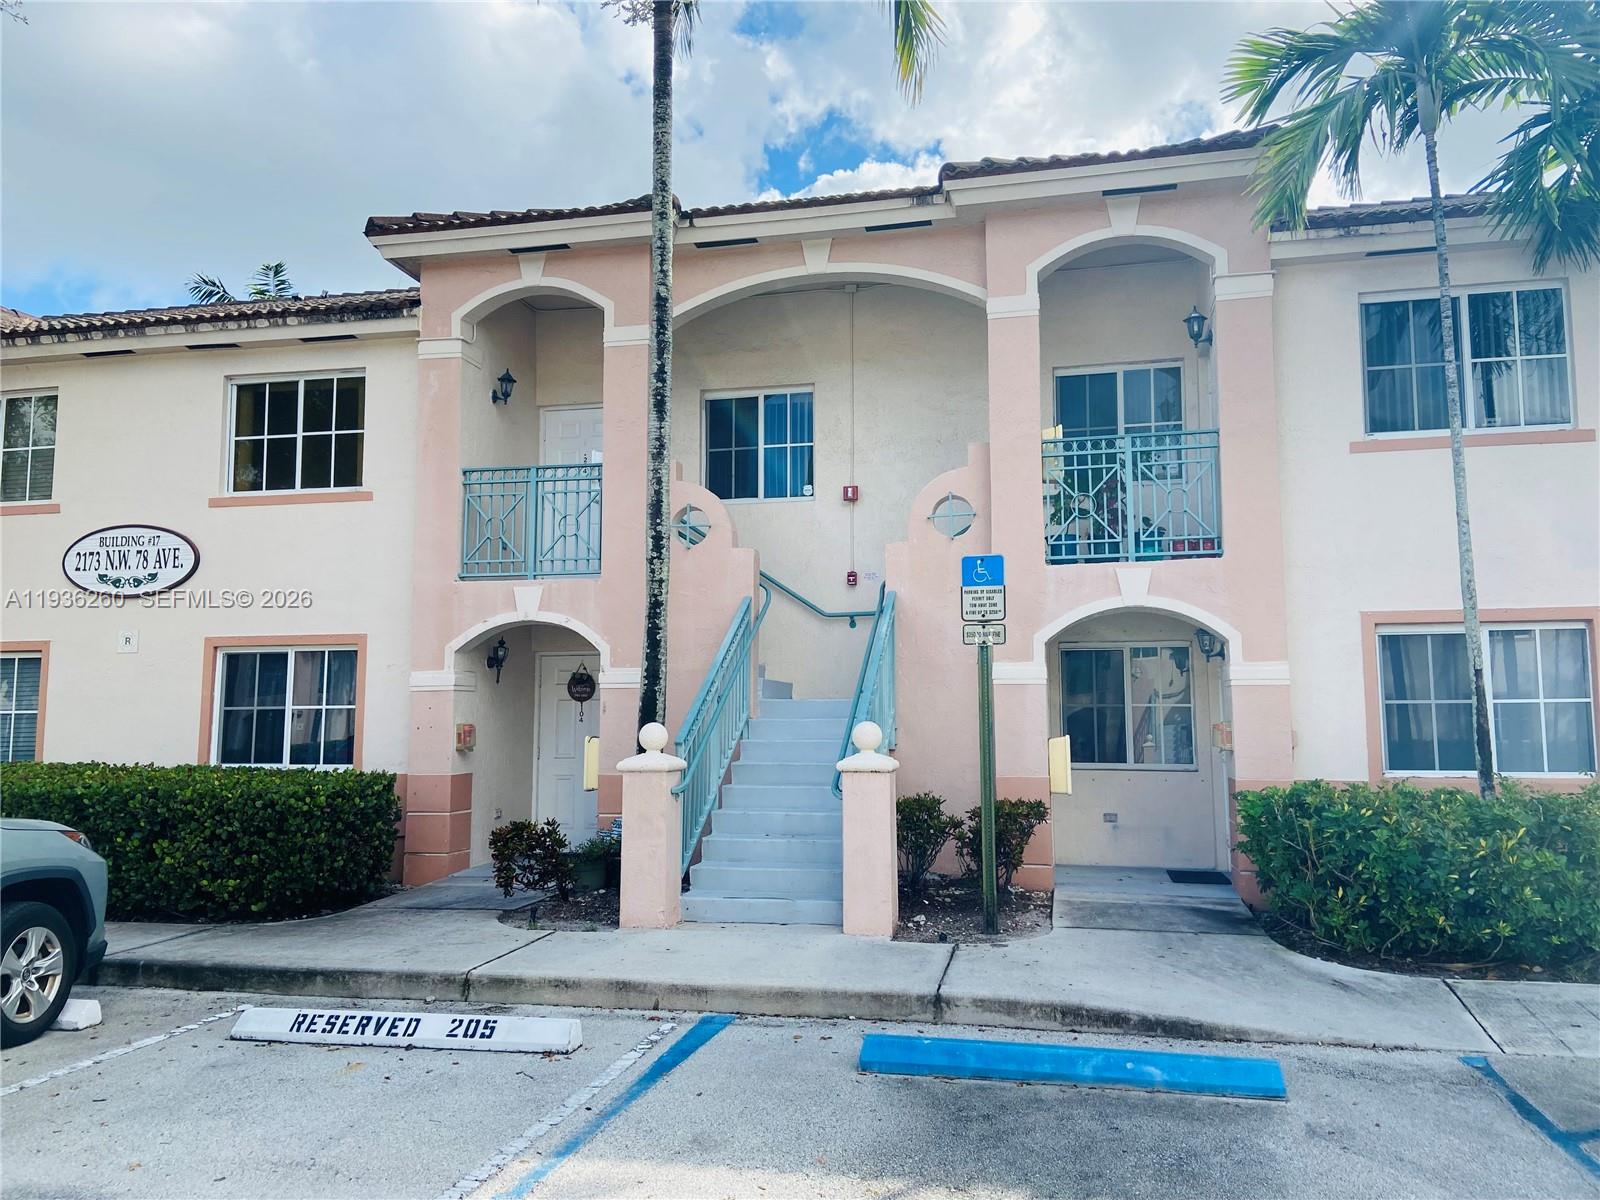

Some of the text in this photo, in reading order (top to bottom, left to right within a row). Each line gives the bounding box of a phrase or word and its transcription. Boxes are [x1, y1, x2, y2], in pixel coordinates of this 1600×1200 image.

[99, 535, 161, 547] BUILDING #17
[75, 547, 184, 572] 2173 N.W. 78 AVE.
[124, 636, 131, 646] R
[289, 1013, 498, 1039] RESERVED 205
